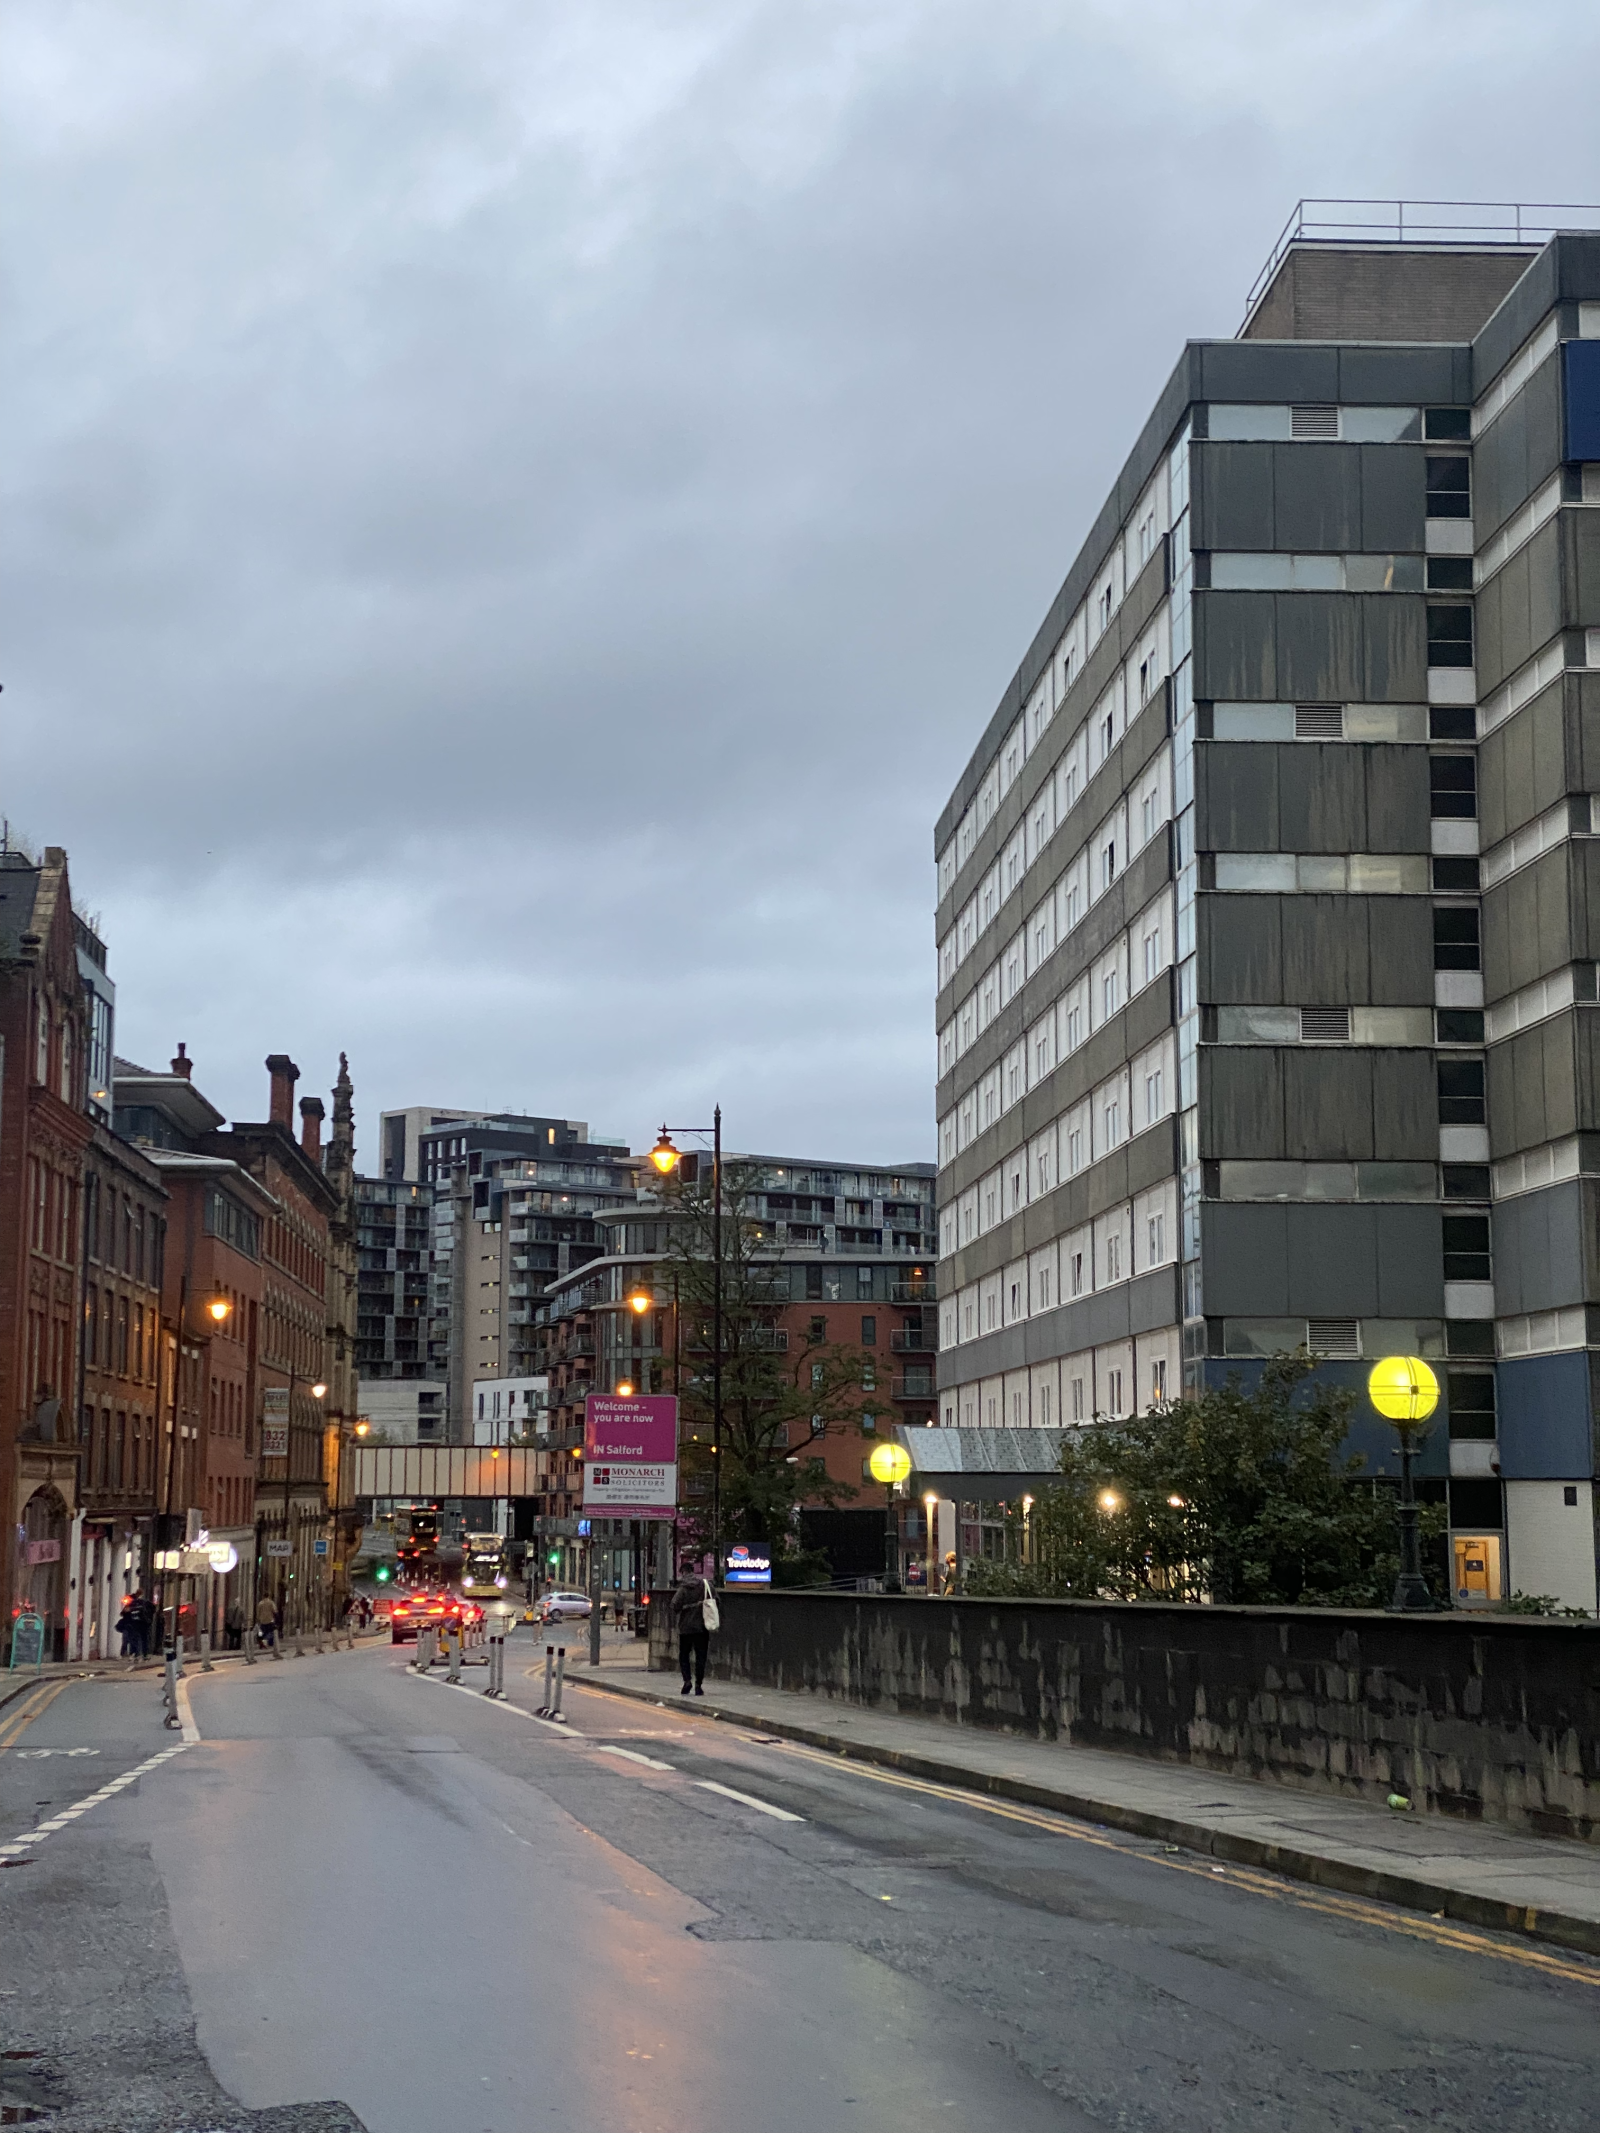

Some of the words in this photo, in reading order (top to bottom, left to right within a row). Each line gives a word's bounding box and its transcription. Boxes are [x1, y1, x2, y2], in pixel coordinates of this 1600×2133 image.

[594, 1402, 640, 1411] Welcome
[594, 1414, 612, 1423] you
[593, 1445, 604, 1454] IN
[607, 1445, 643, 1455] Salford
[611, 1468, 665, 1476] MONARCH
[269, 1544, 289, 1552] MAP
[727, 1557, 770, 1569] Travelodge
